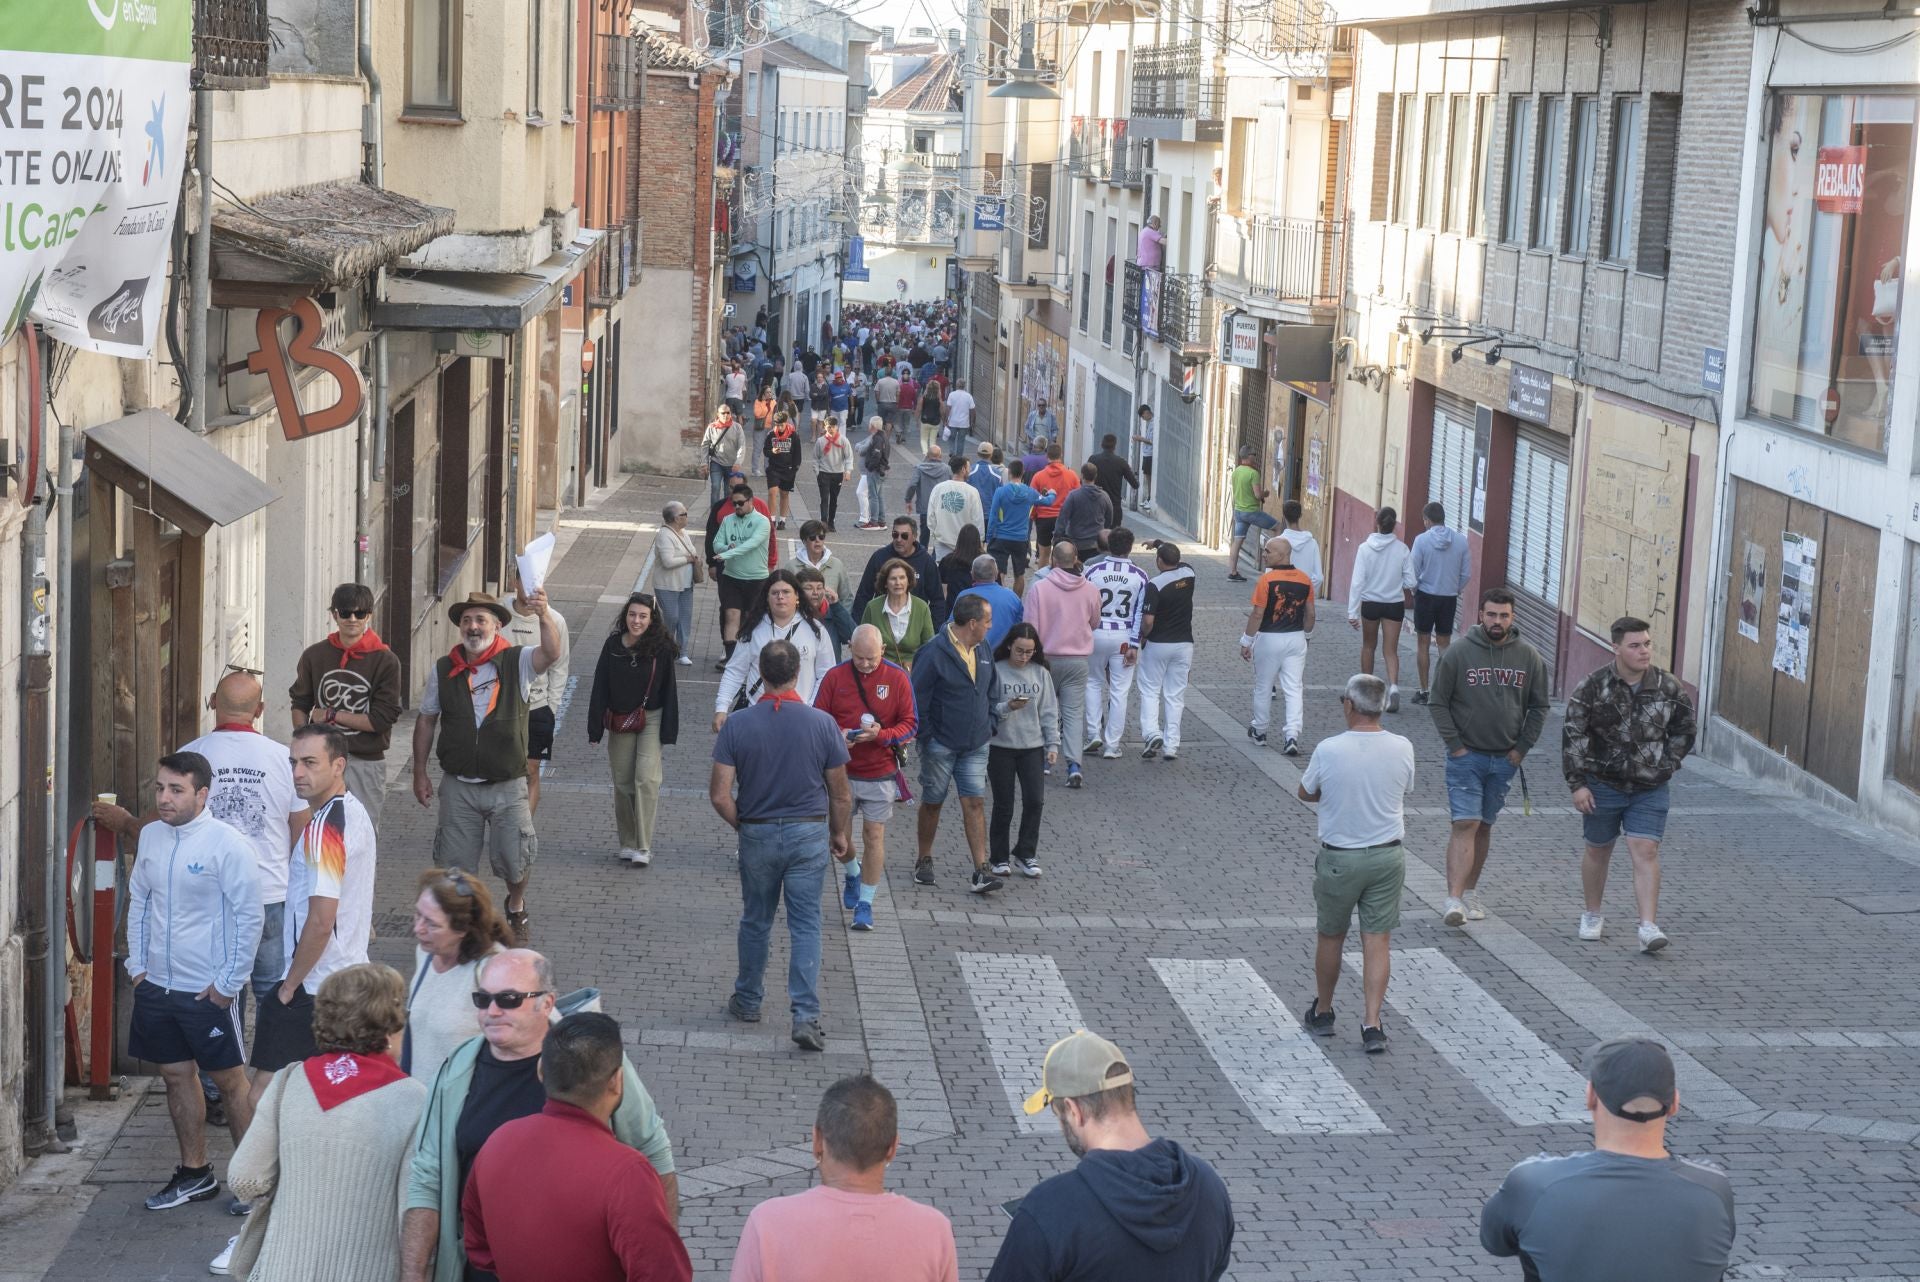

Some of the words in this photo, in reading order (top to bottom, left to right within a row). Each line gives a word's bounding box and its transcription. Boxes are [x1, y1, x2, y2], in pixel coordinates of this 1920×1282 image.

[61, 86, 123, 139] 2024
[51, 149, 122, 185] ONLINE
[1816, 163, 1864, 198] REBAJAS
[1236, 322, 1256, 331] PUERTAS
[1234, 334, 1257, 351] TEYSAN
[1708, 355, 1720, 367] CALLE
[1704, 370, 1720, 384] PARRAS
[1103, 574, 1128, 584] BRUNO
[1100, 588, 1132, 618] 23
[1003, 683, 1040, 694] POLO
[232, 767, 266, 778] REVUELTO
